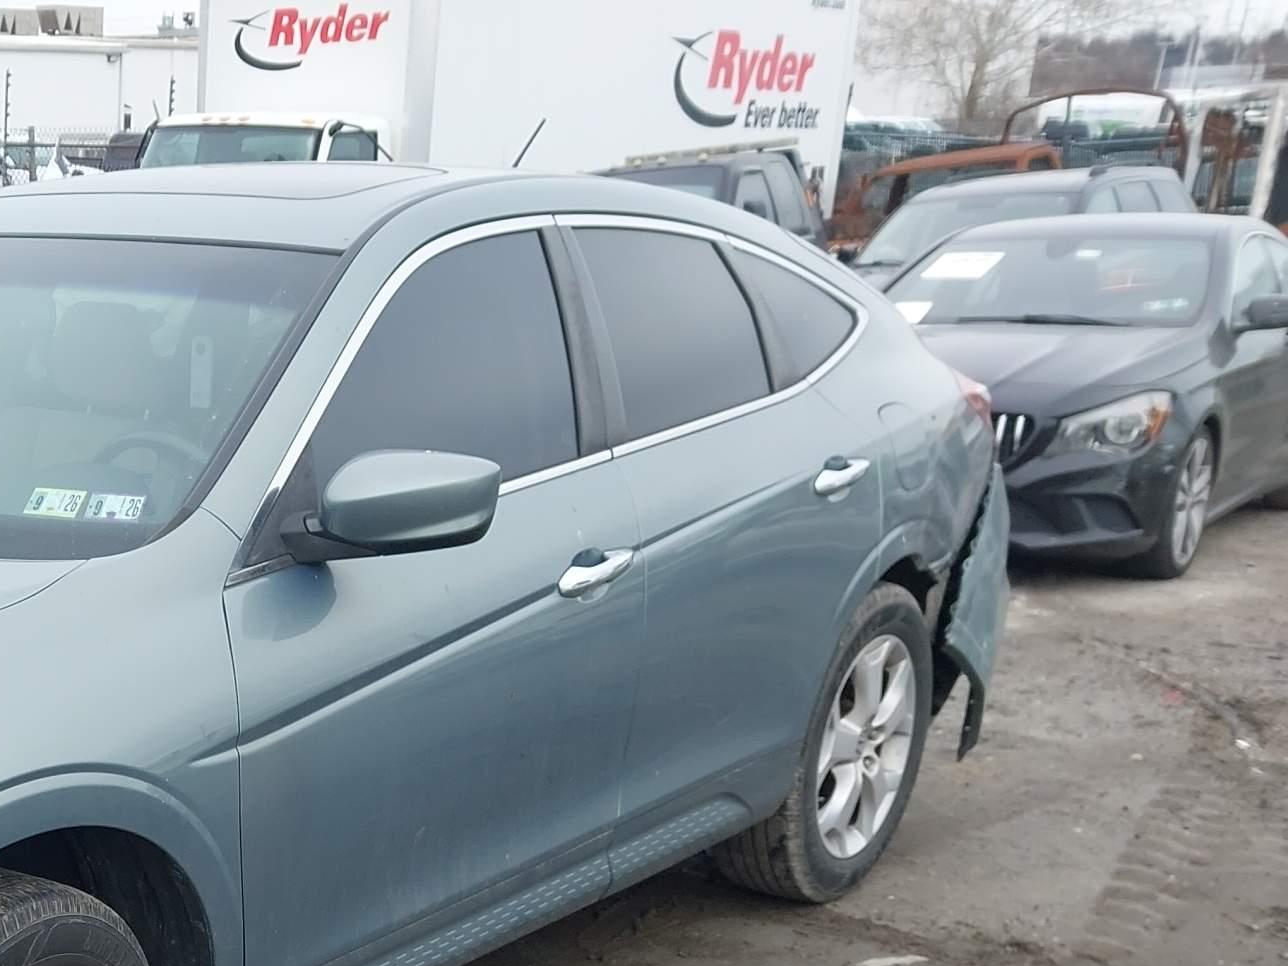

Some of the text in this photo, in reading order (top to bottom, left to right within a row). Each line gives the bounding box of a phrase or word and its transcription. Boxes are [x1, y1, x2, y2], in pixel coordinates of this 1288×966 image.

[268, 3, 391, 55] Ryder
[708, 29, 816, 104] Ryder
[743, 99, 776, 128] Ever
[32, 494, 81, 513] 9 26
[93, 498, 142, 517] 9 26
